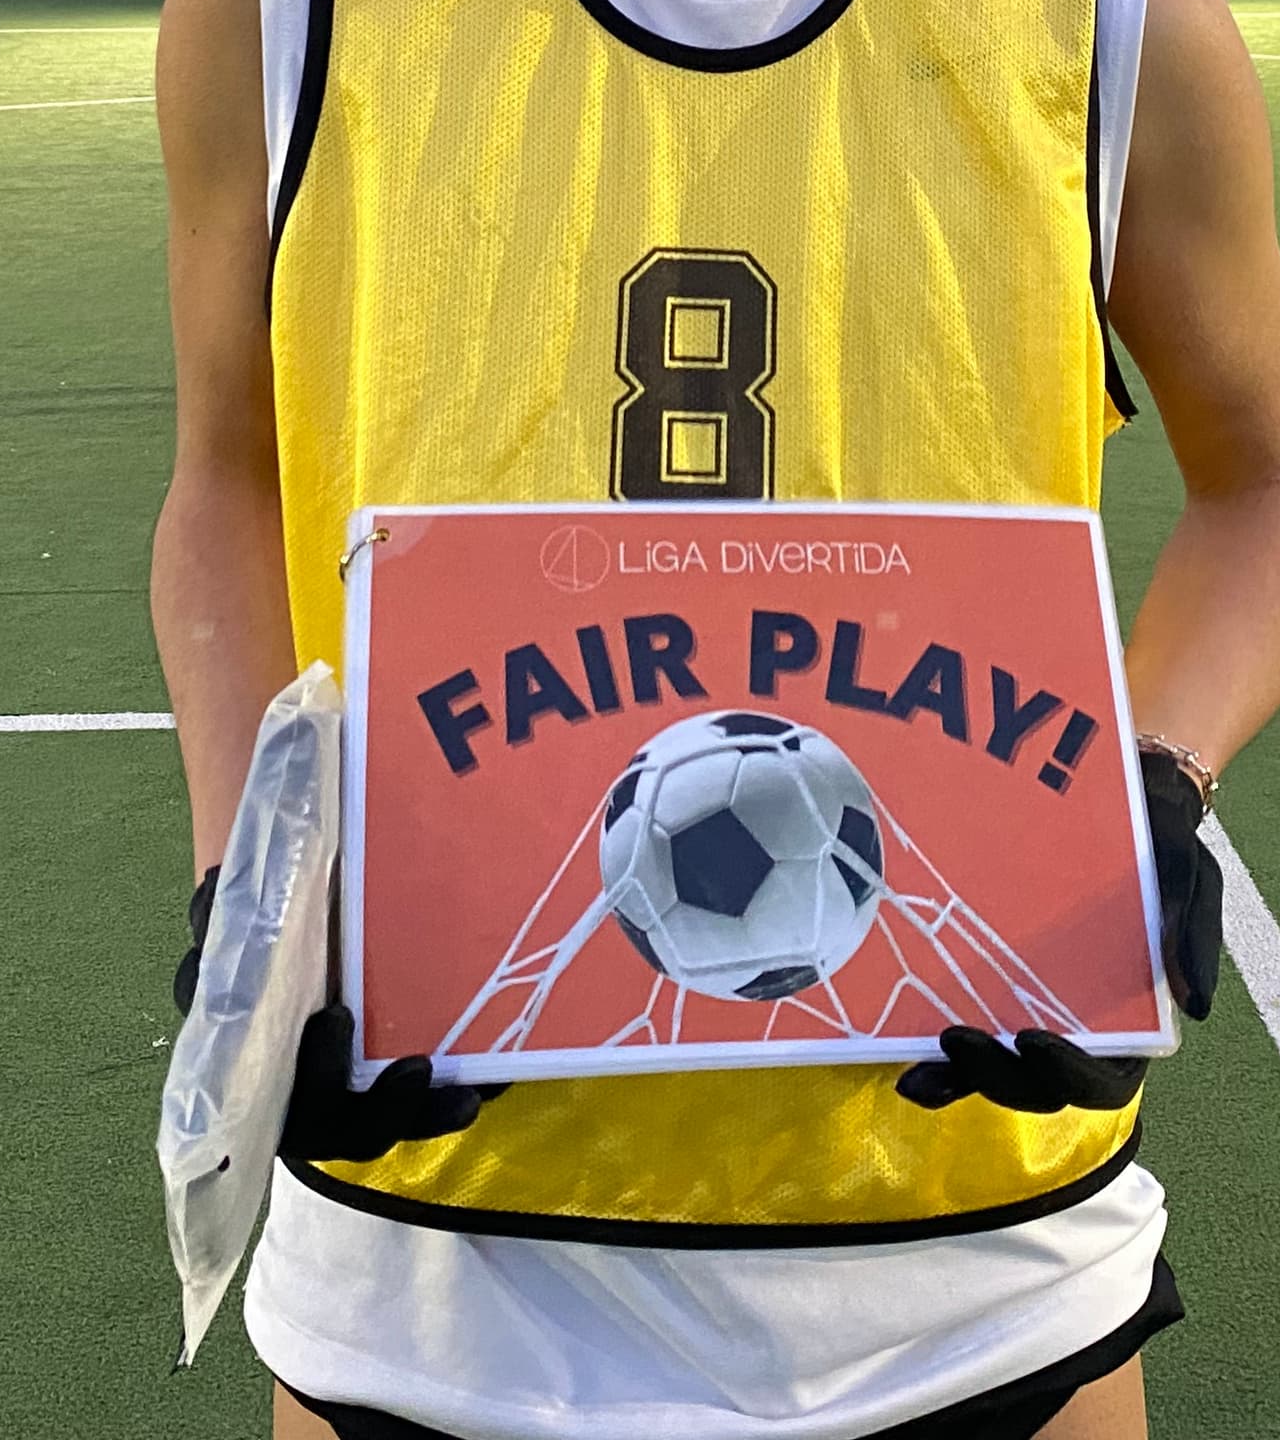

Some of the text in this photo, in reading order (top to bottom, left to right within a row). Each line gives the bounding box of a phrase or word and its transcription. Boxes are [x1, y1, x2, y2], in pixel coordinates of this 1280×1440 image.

[610, 247, 778, 501] 8
[417, 610, 1101, 796] FAIR PLAY!
